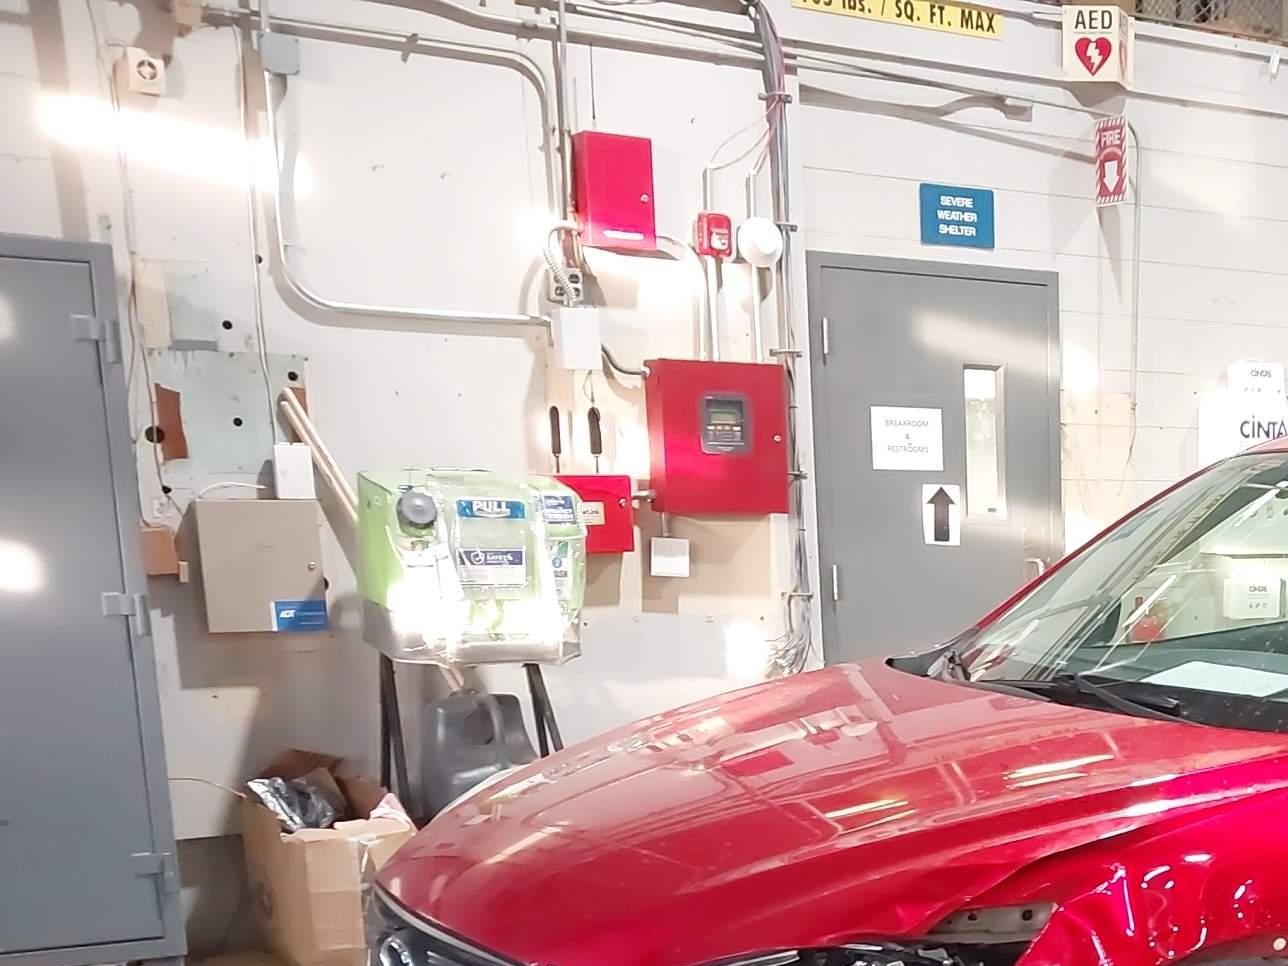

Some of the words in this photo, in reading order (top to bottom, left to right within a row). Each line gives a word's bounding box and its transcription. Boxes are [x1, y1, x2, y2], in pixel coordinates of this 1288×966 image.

[894, 1, 921, 21] SQ.
[929, 4, 952, 27] FT.
[960, 9, 996, 34] MAX
[1074, 10, 1113, 30] AED
[1101, 129, 1121, 148] FIRE
[940, 195, 974, 208] SEVERE
[936, 209, 978, 222] WEATHER
[938, 223, 977, 237] SHELTER
[472, 500, 511, 514] PULL
